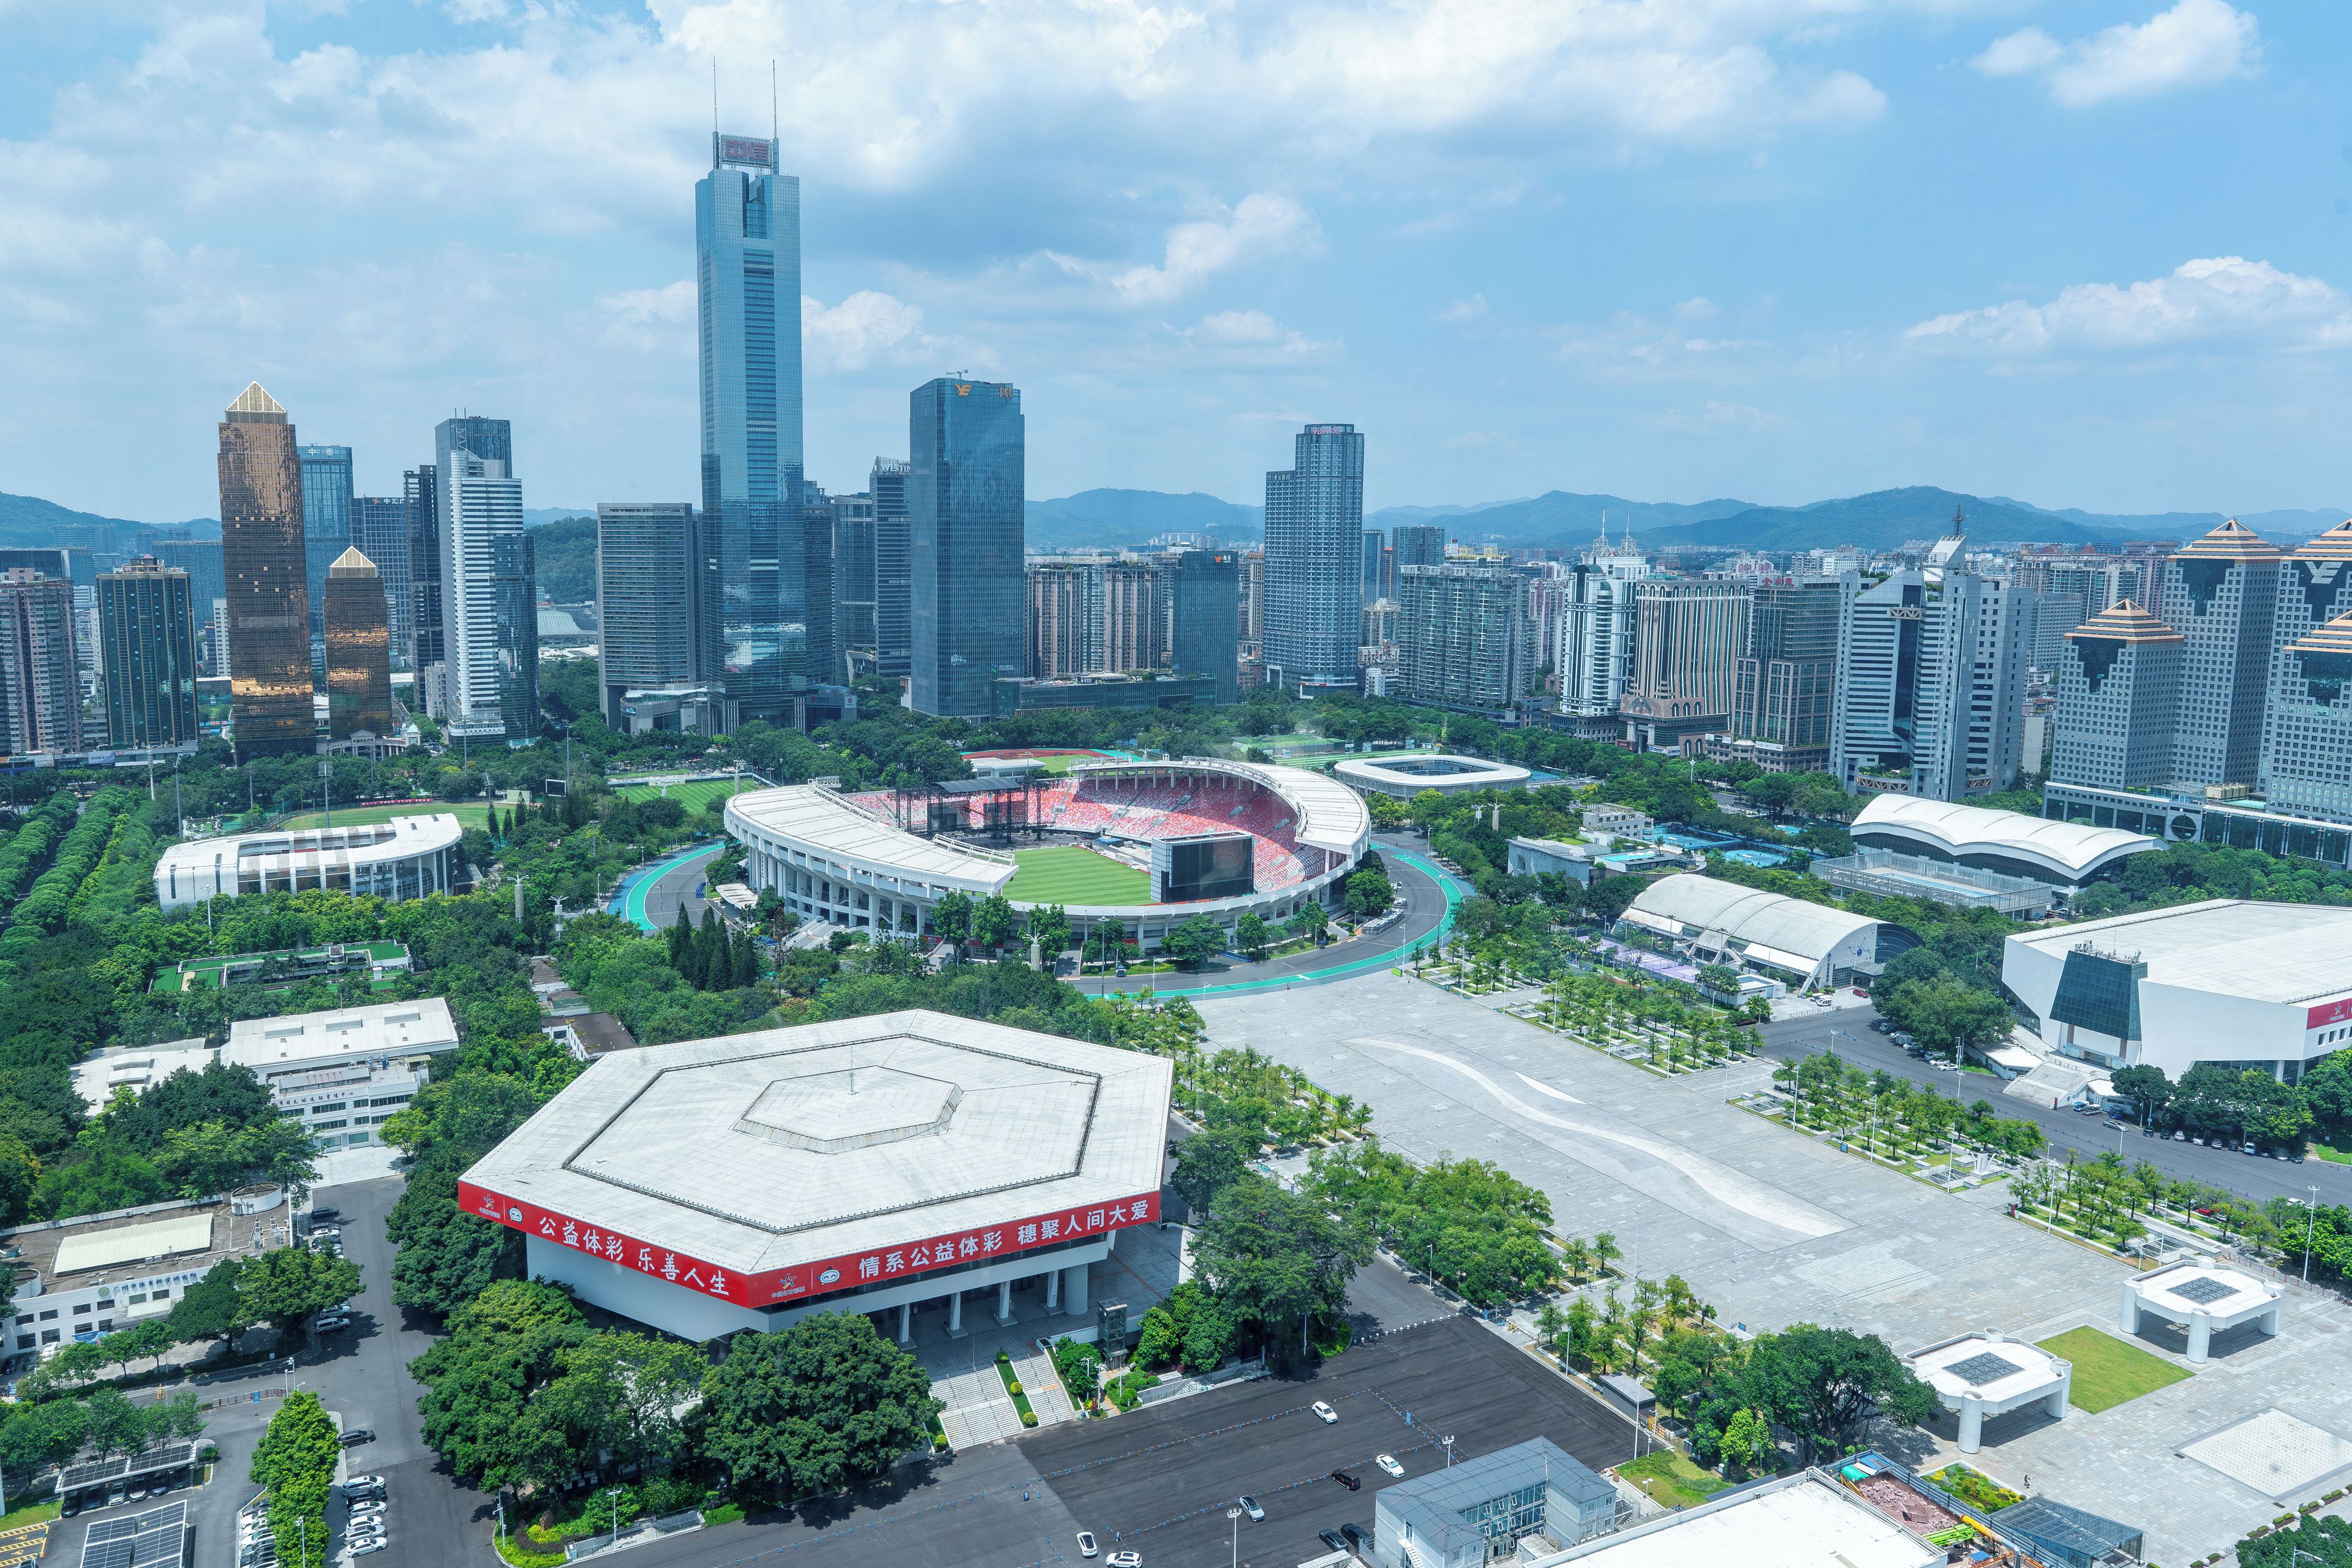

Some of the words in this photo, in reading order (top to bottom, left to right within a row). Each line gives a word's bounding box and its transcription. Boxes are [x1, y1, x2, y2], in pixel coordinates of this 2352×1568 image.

[725, 140, 769, 160] 中信
[859, 1230, 1003, 1280] 情系公益体彩
[1017, 1199, 1150, 1246] 穗聚人间大爱
[539, 1216, 624, 1262] 公益体彩
[638, 1247, 729, 1296] 乐善人生
[113, 1272, 197, 1293] 广州市体育科学研究所
[771, 1286, 805, 1298] 中国体育彩票
